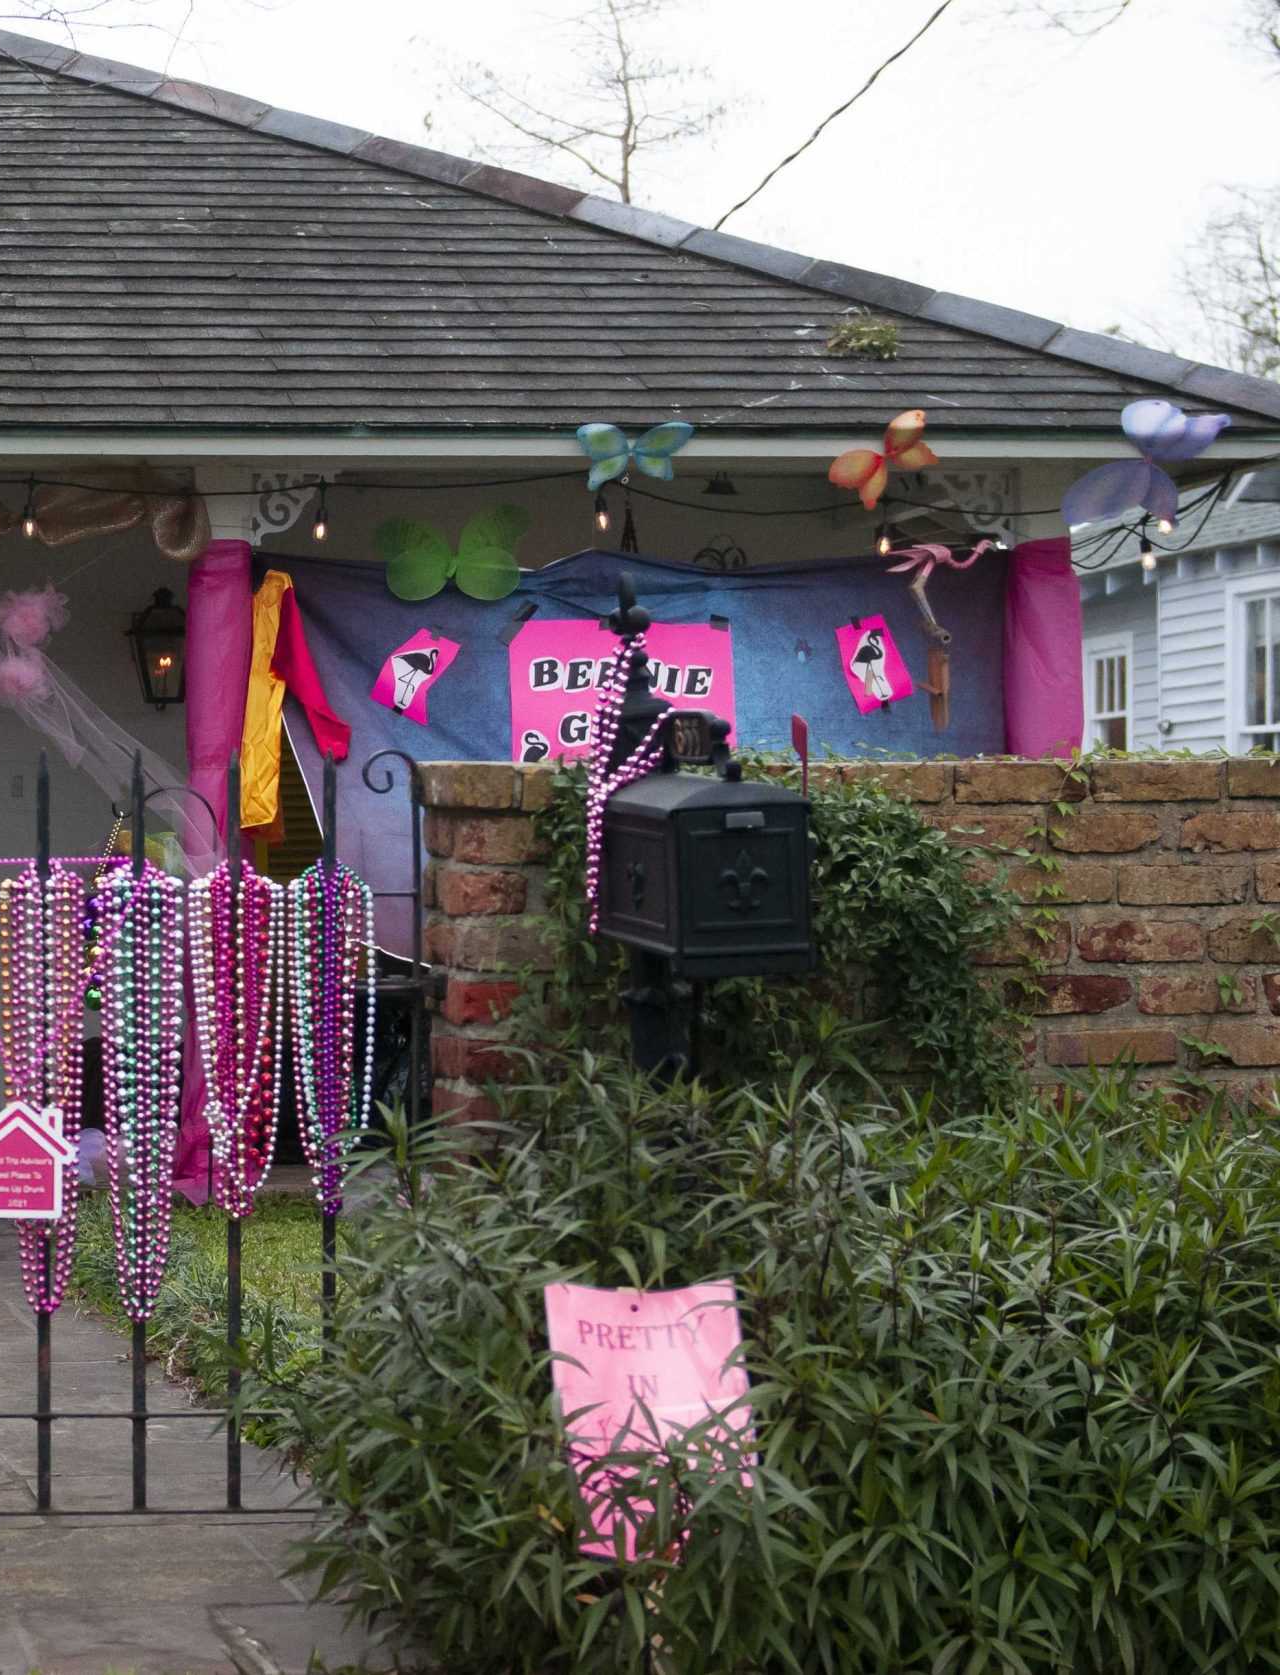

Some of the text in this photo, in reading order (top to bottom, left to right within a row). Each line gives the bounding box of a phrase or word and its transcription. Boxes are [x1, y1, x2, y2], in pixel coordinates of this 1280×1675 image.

[10, 1185, 22, 1194] Up
[577, 1312, 706, 1351] PRETTY
[627, 1374, 658, 1400] IN
